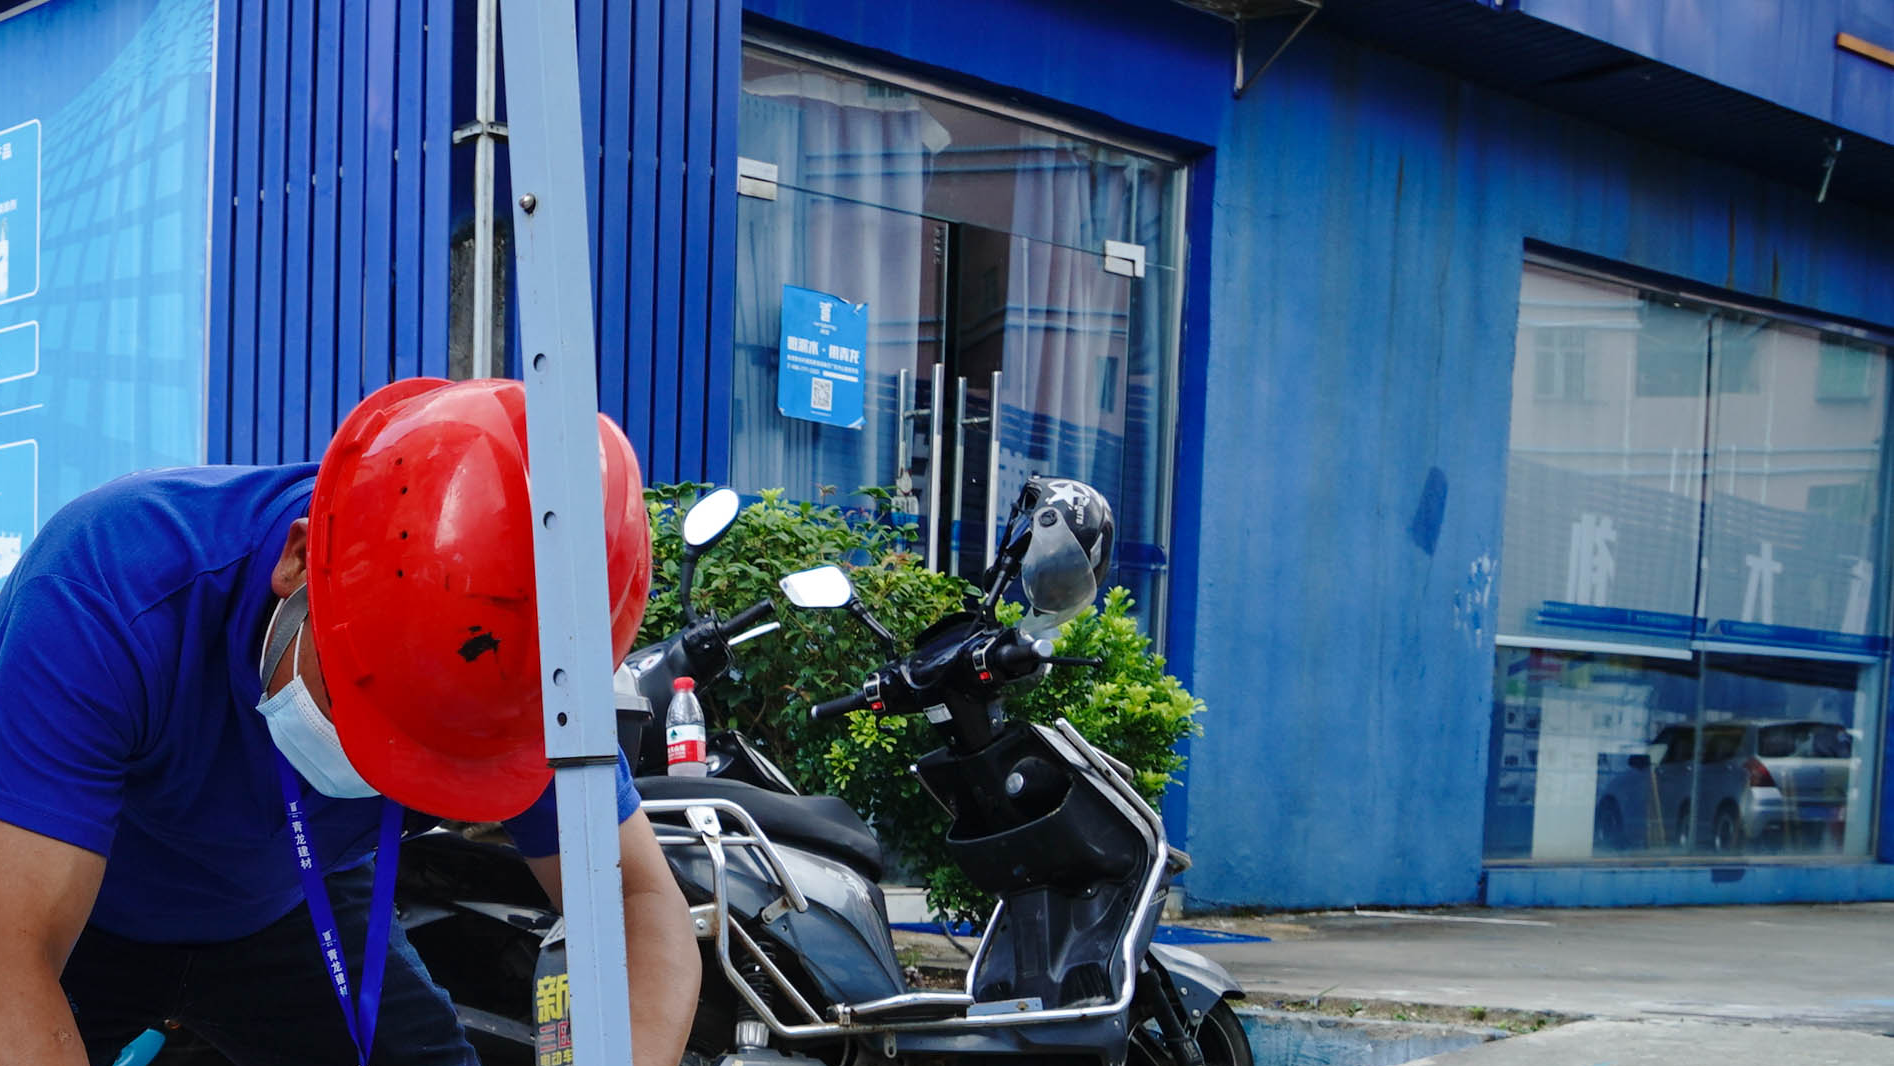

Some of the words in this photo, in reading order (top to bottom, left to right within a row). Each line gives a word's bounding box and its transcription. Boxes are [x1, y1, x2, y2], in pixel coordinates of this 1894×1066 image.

[292, 821, 312, 870] 青龙建材
[327, 949, 348, 997] 青龙建材
